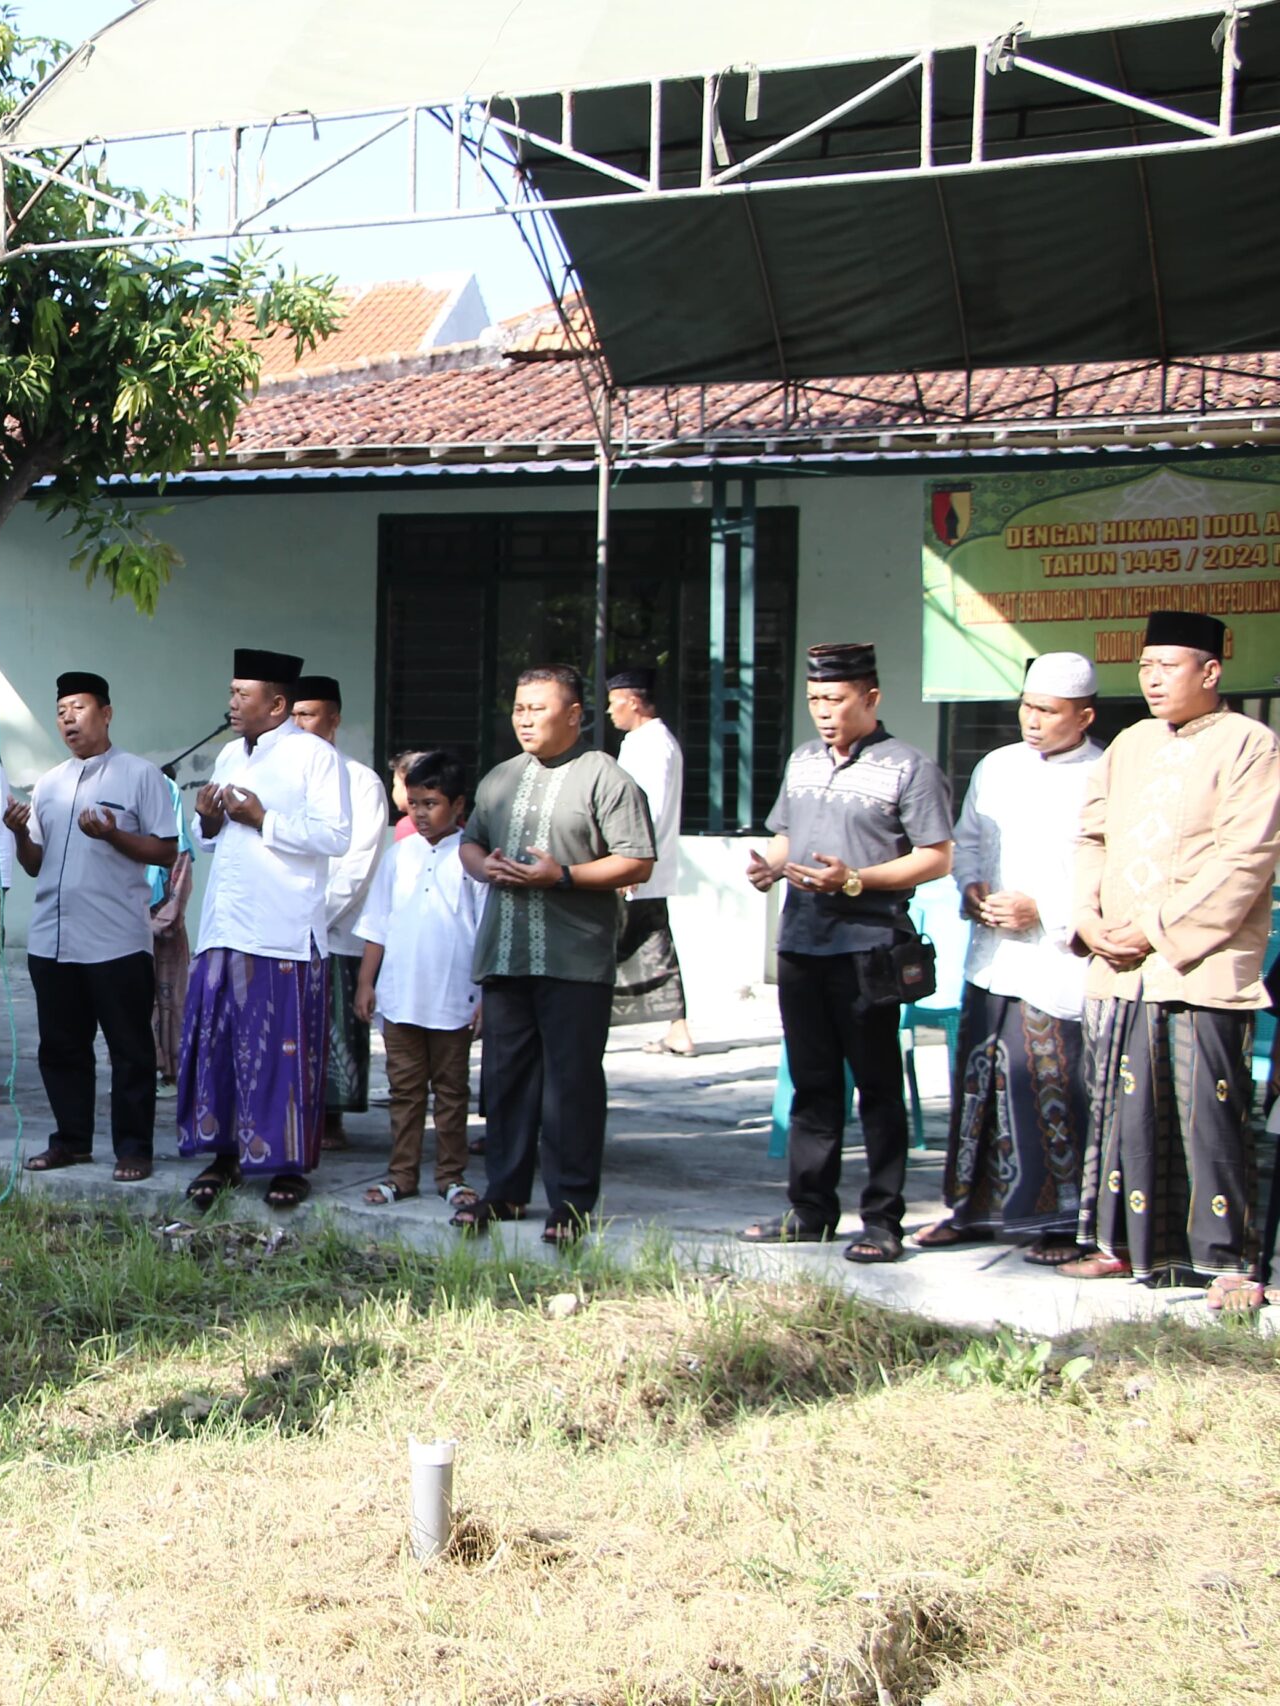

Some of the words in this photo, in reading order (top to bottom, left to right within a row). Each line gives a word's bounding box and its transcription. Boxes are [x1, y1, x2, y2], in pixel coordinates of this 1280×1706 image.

[1005, 523, 1097, 549] DENGAN
[1101, 516, 1198, 544] HIKMAH
[1202, 512, 1259, 538] IDUL
[1039, 551, 1117, 577] TAHUN
[1121, 547, 1180, 573] 1445
[1184, 546, 1198, 571] /
[1203, 543, 1267, 570] 2024
[1019, 590, 1084, 622] BERKURBAN
[1085, 587, 1124, 620] UNTUK
[1125, 585, 1181, 618] KETAATAN
[1183, 583, 1207, 616] DAN
